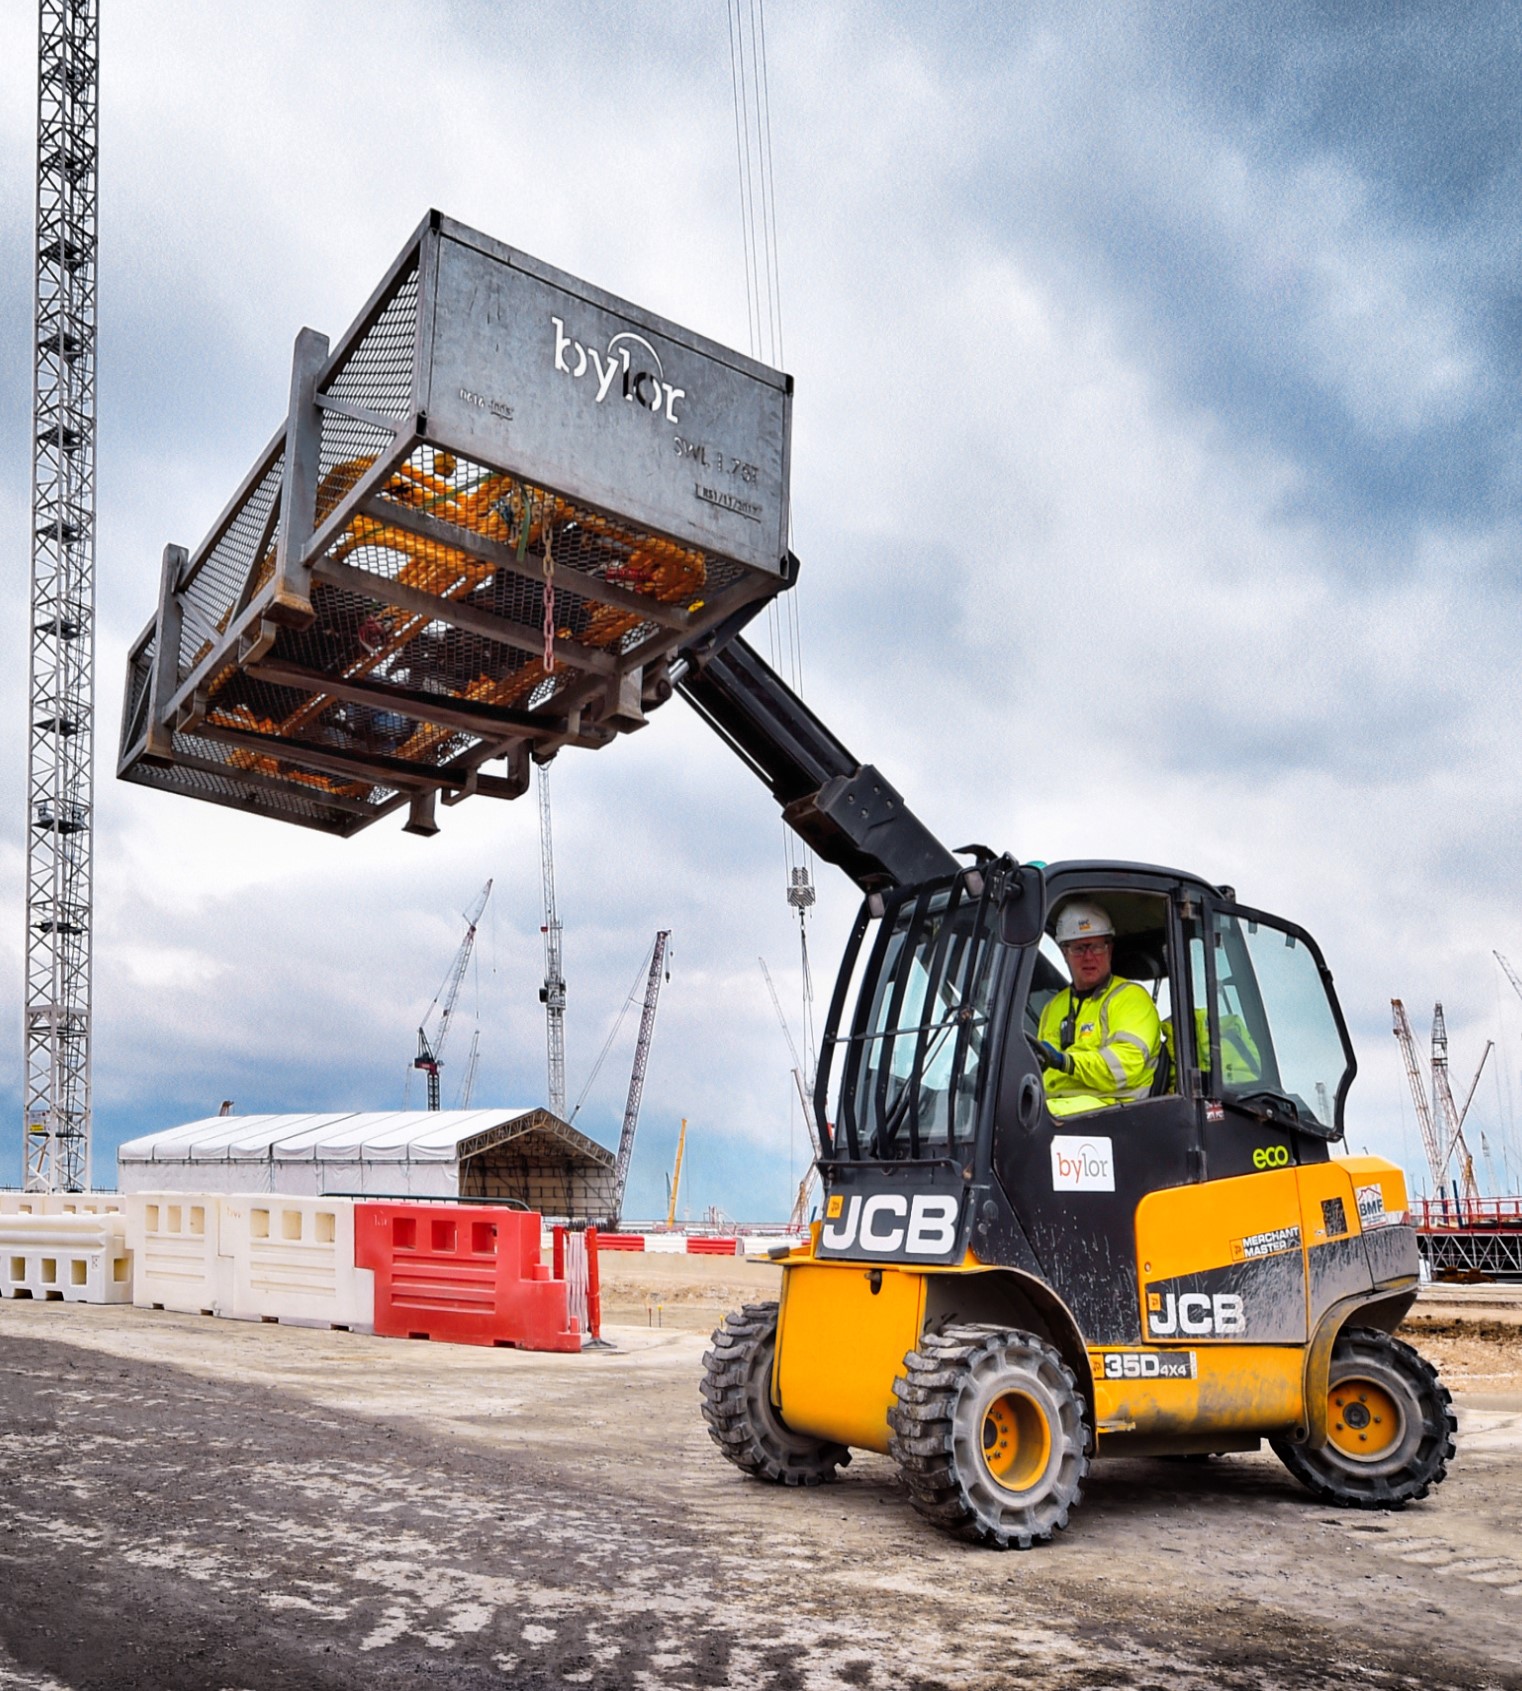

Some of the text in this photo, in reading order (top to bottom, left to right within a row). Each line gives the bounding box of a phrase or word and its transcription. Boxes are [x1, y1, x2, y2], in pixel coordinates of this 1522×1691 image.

[551, 316, 686, 424] bylor
[1056, 1152, 1108, 1184] bylor
[1253, 1145, 1289, 1169] eco
[1359, 1199, 1383, 1216] BMF
[822, 1194, 959, 1255] JCB
[1242, 1227, 1299, 1248] MERCHANT
[1244, 1240, 1288, 1258] MASTER
[1148, 1293, 1247, 1335] JCB
